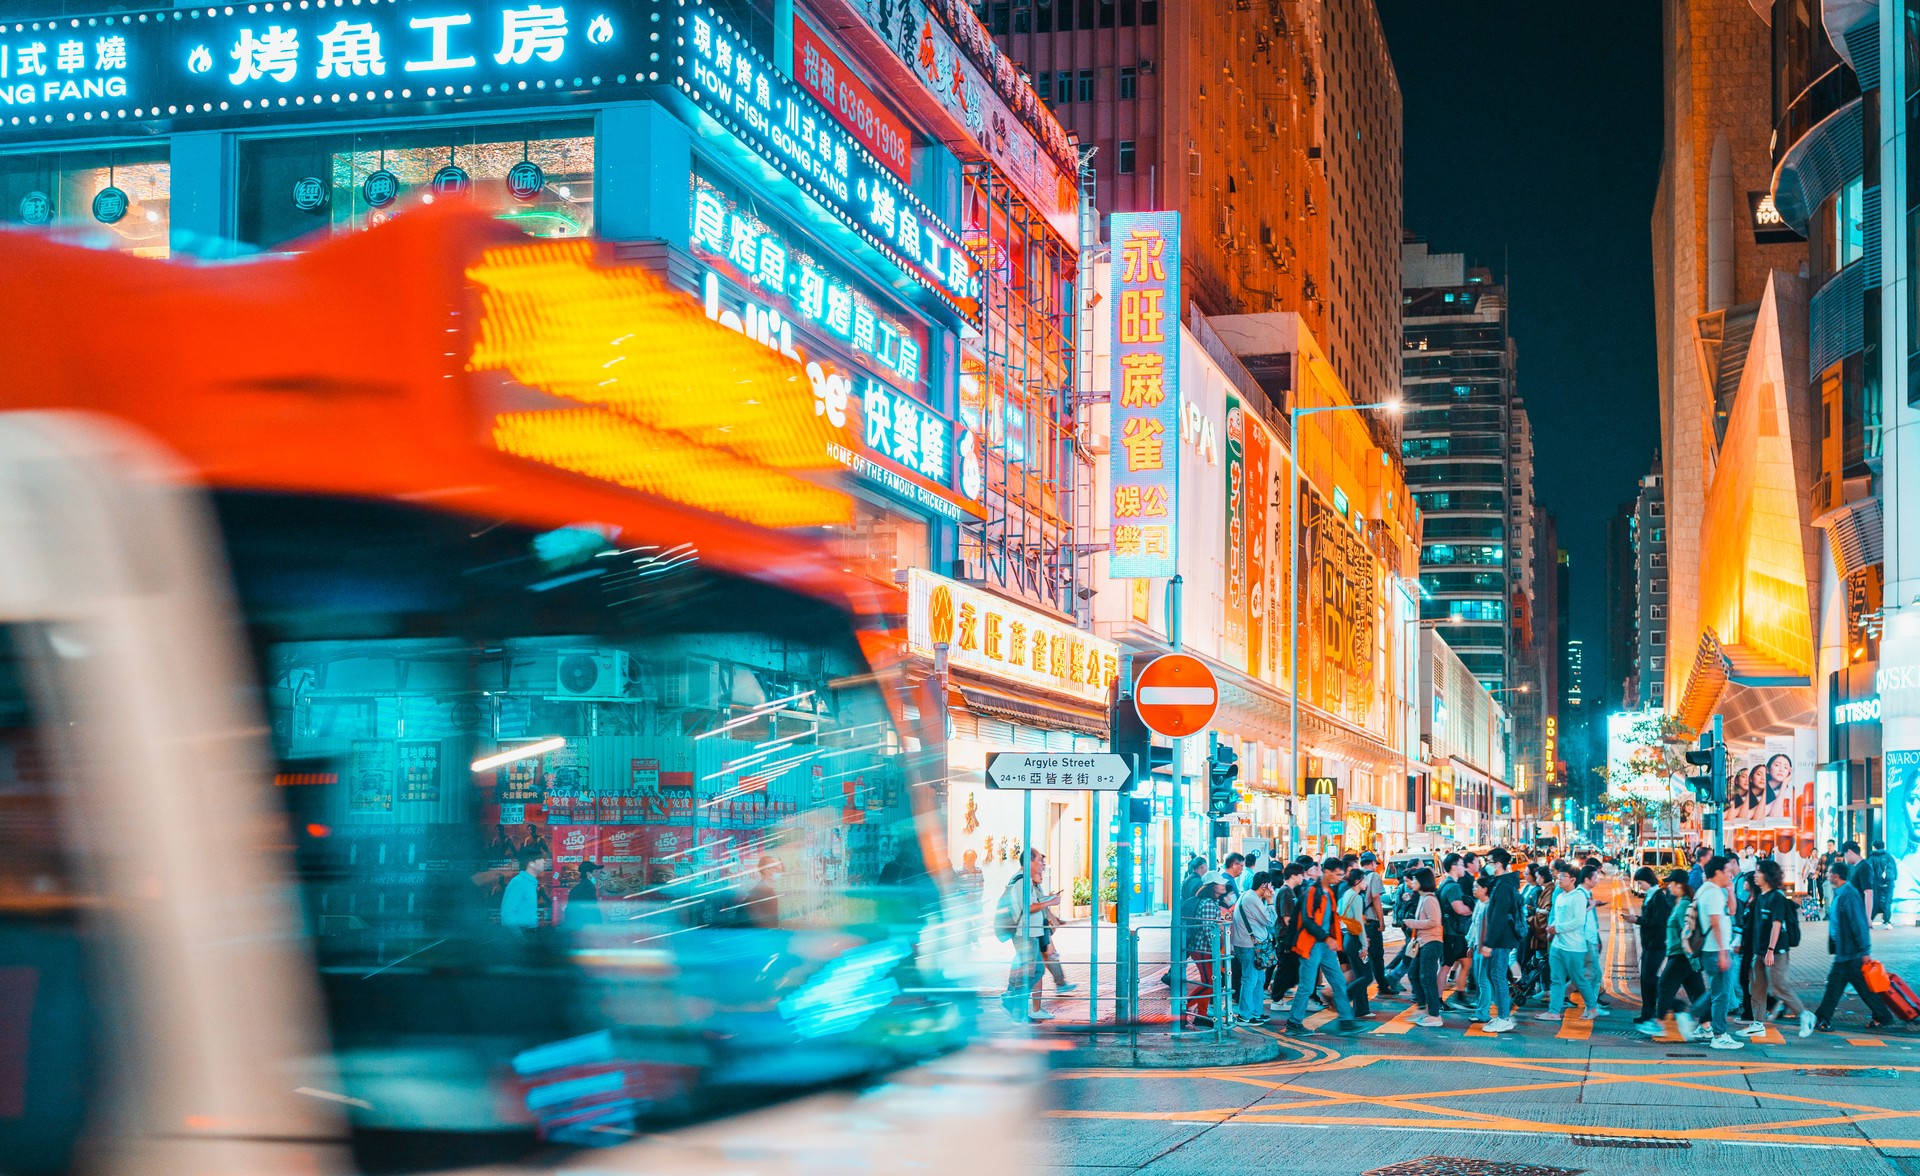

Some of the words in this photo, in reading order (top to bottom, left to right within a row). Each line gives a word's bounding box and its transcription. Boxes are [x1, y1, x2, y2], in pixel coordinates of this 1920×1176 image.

[229, 5, 569, 86] 烤魚工房
[43, 76, 127, 102] FANG
[803, 40, 836, 106] 招租
[838, 81, 906, 168] 63681908
[694, 59, 732, 104] HOW
[735, 93, 769, 137] FISH
[771, 127, 811, 172] GONG
[812, 159, 848, 202] FANG
[871, 179, 969, 298] 烤魚工房
[1757, 211, 1784, 225] 190
[864, 379, 944, 481] 快樂蜂
[826, 442, 852, 467] HOME
[853, 456, 865, 472] OF
[866, 462, 882, 482] THE
[883, 470, 915, 498] FAMOUS
[917, 487, 961, 520] CHICKENJOY
[1024, 757, 1058, 769] Argyle
[1061, 757, 1096, 768] Street
[1030, 772, 1090, 785] 亞皆老街
